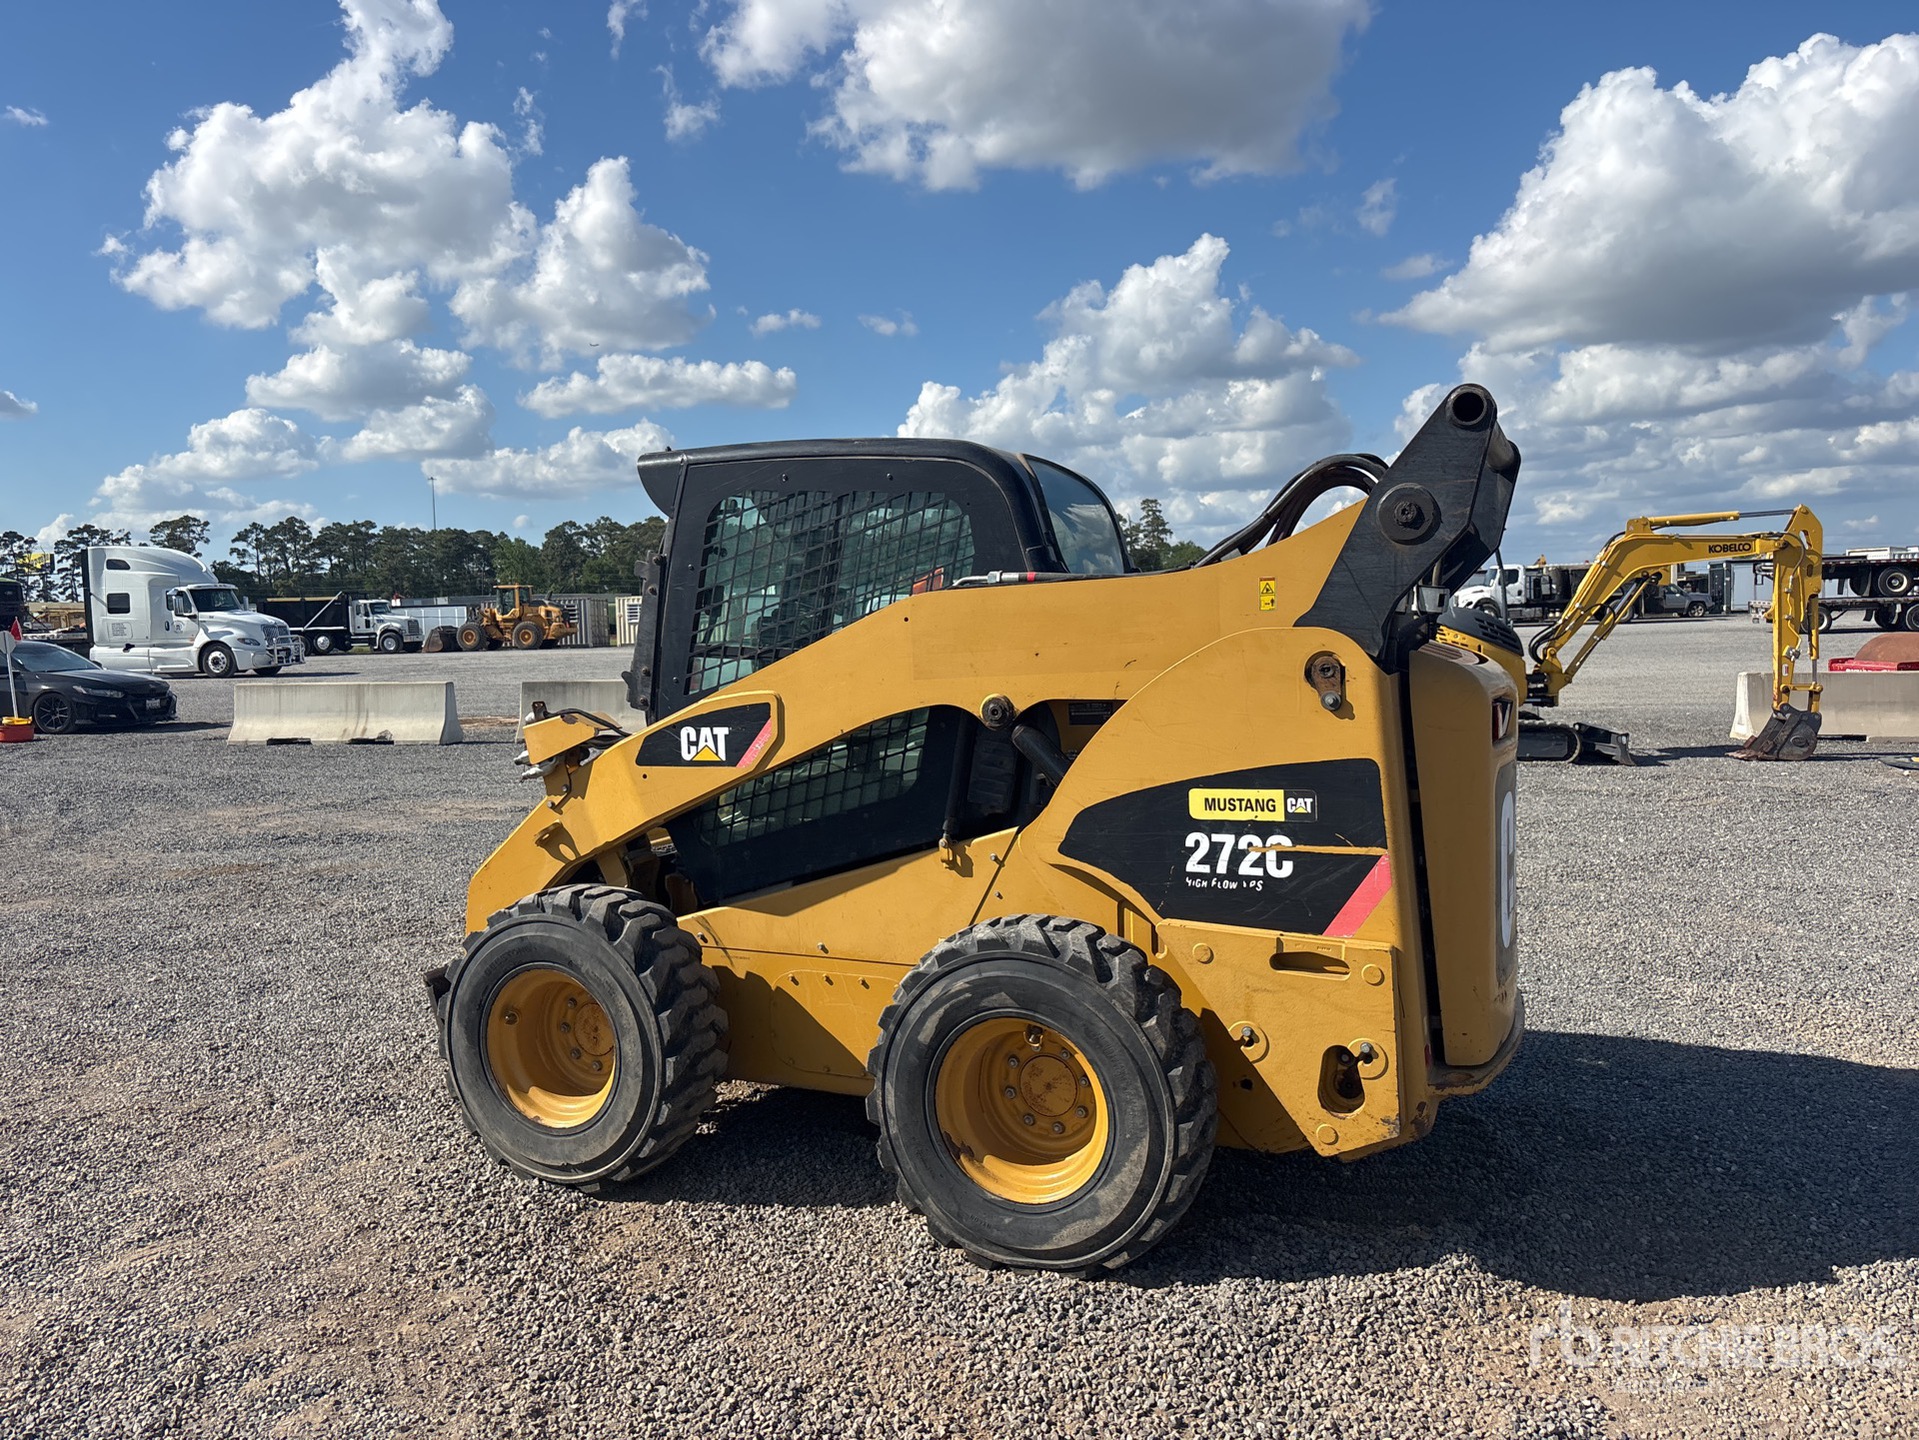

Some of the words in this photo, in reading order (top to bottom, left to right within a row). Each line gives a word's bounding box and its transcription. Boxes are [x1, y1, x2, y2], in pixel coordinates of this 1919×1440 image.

[1708, 542, 1752, 554] KOBELCO
[680, 726, 729, 761] CAT
[1203, 797, 1277, 813] MUSTANG
[1286, 797, 1314, 814] CAT
[1184, 831, 1294, 879] 272C
